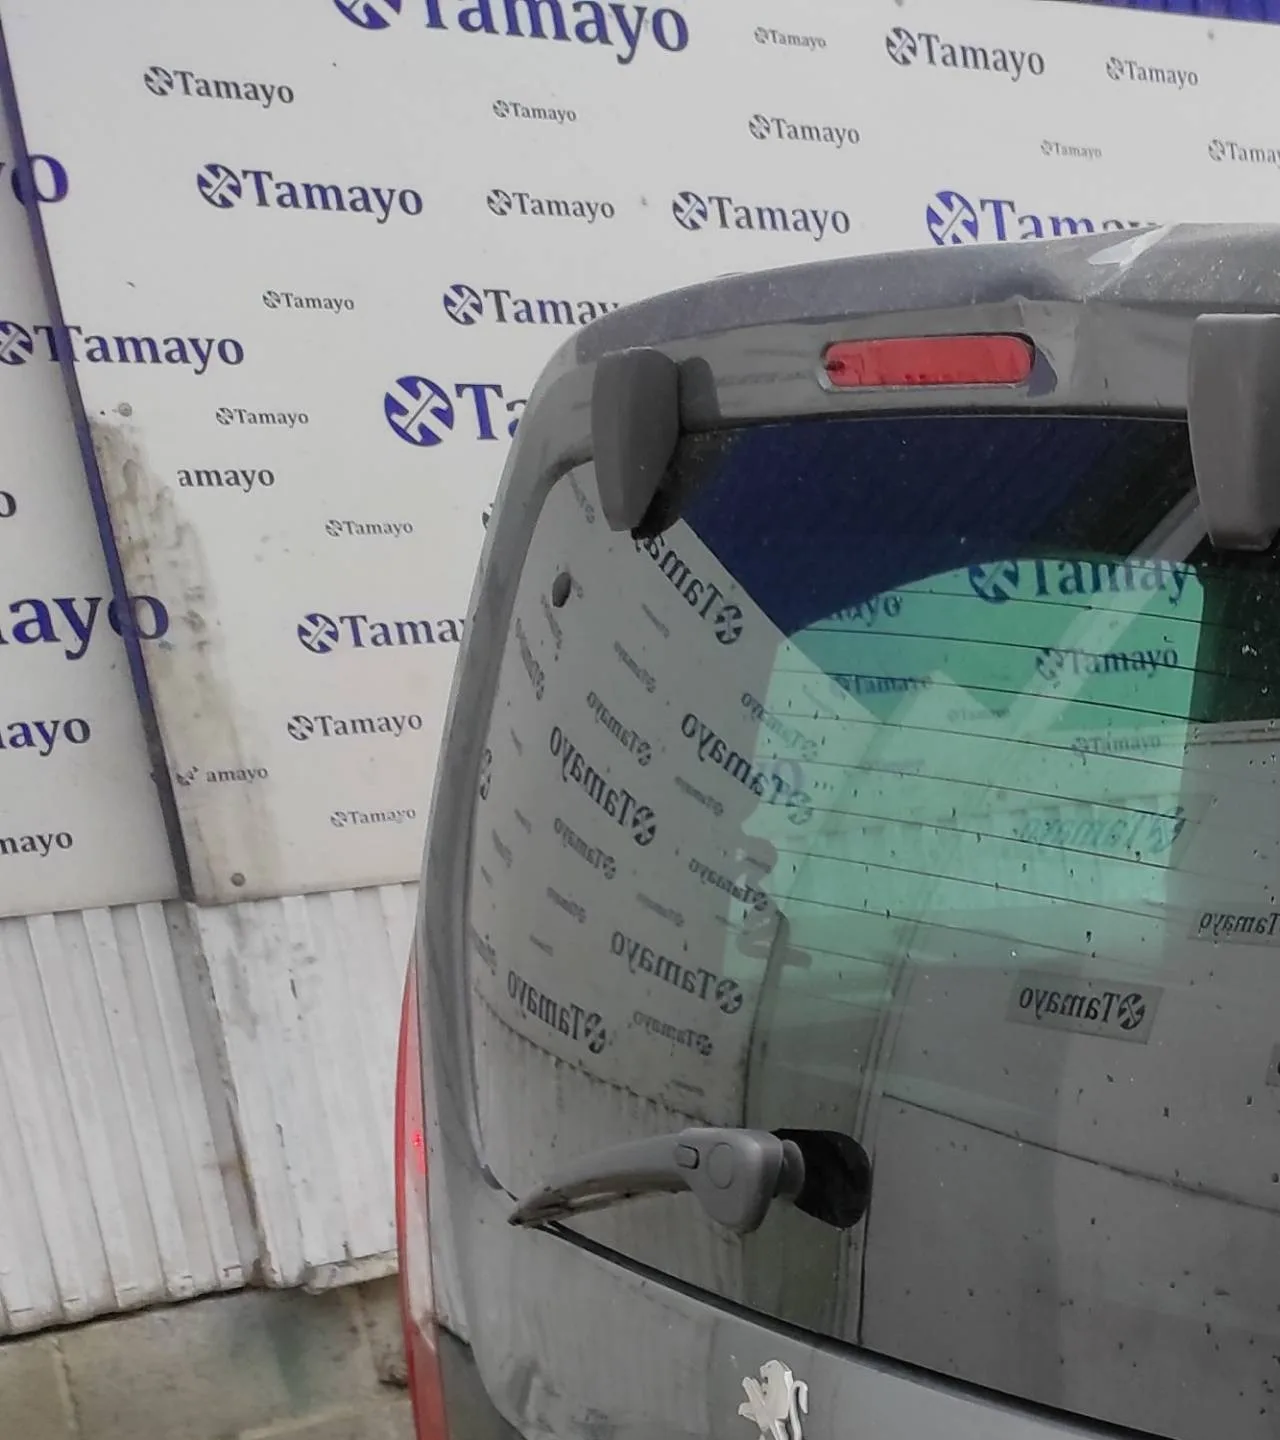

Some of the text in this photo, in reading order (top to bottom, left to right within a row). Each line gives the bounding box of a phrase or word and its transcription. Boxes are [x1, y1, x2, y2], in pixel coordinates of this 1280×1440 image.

[765, 29, 827, 49] Tamayo
[918, 31, 1045, 81] Tamayo
[172, 69, 295, 107] Tamayo
[1124, 60, 1199, 89] Tamayo
[508, 102, 577, 124] Tamayo
[771, 117, 860, 149] Tamayo
[1054, 140, 1102, 159] Tamayo
[242, 170, 424, 223] Tamayo
[514, 192, 615, 223] Tamayo
[709, 195, 851, 241] Tamayo
[281, 292, 355, 312] Tamayo
[483, 288, 620, 326] Tama
[33, 325, 245, 375] Tamayo
[234, 408, 310, 428] Tamayo
[177, 468, 275, 493] amayo
[342, 520, 413, 537] Tamayo
[1034, 559, 1189, 606] Tamay
[0, 595, 169, 660] ayo
[338, 614, 465, 648] Tama
[0, 718, 91, 757] ayo
[314, 710, 423, 738] Tamayo
[206, 766, 269, 784] amayo
[347, 807, 416, 826] Tamayo
[0, 832, 73, 857] mayo
